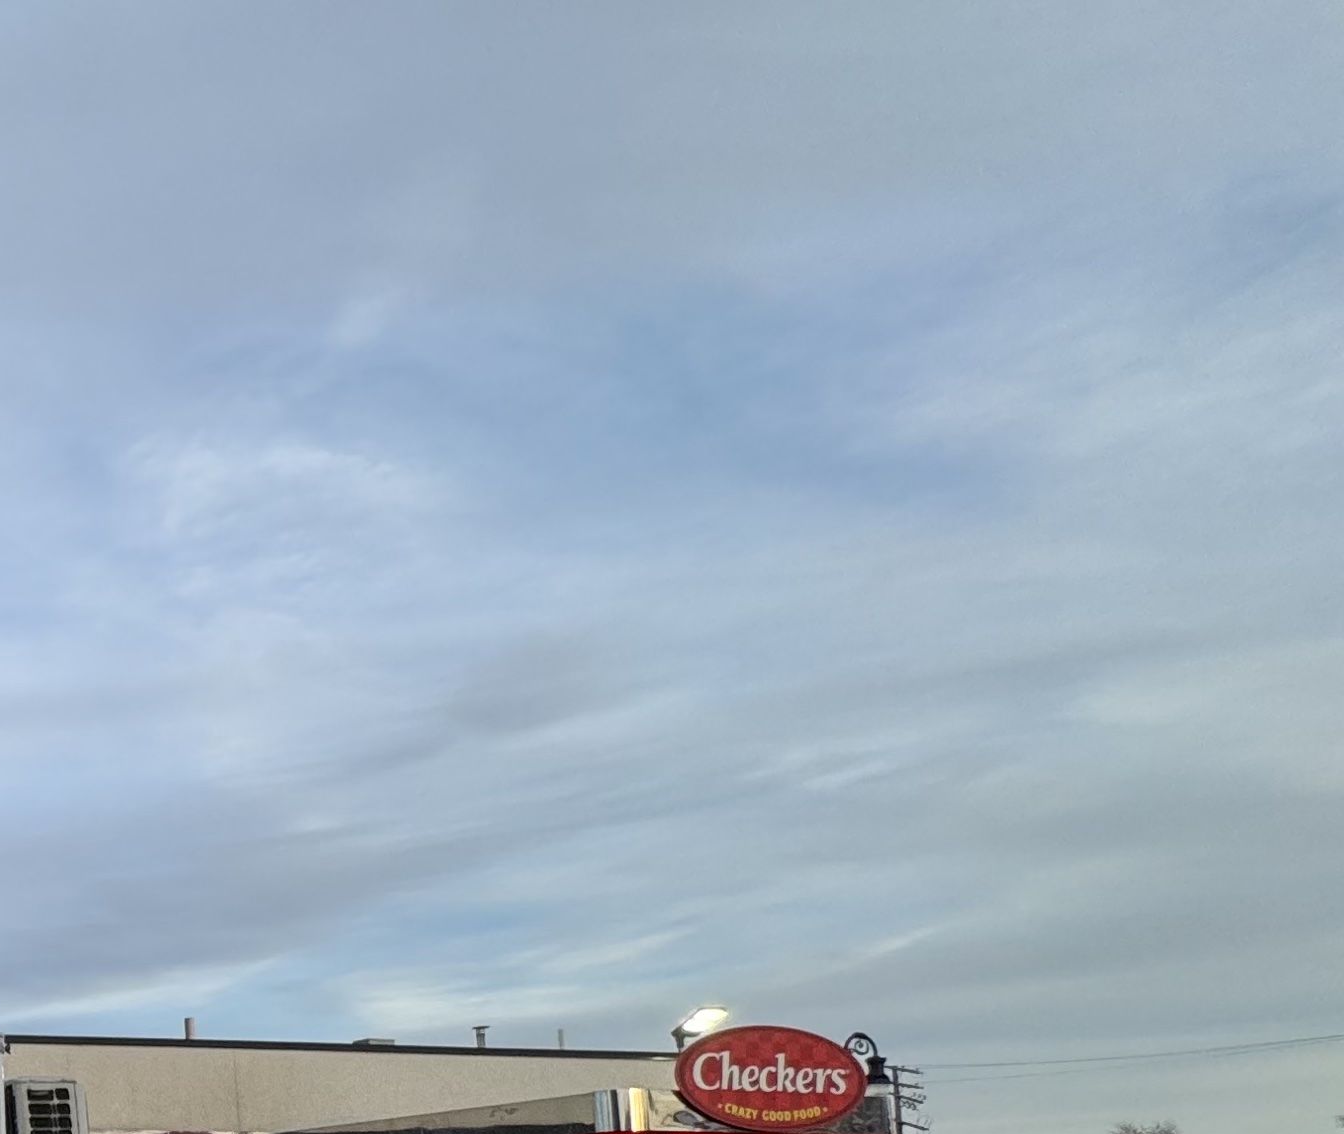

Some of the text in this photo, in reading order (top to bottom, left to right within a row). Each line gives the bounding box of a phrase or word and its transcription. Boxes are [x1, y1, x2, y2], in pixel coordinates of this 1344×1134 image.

[693, 1050, 848, 1096] Checkers
[724, 1103, 822, 1121] CRAZY GOOD FOOD
